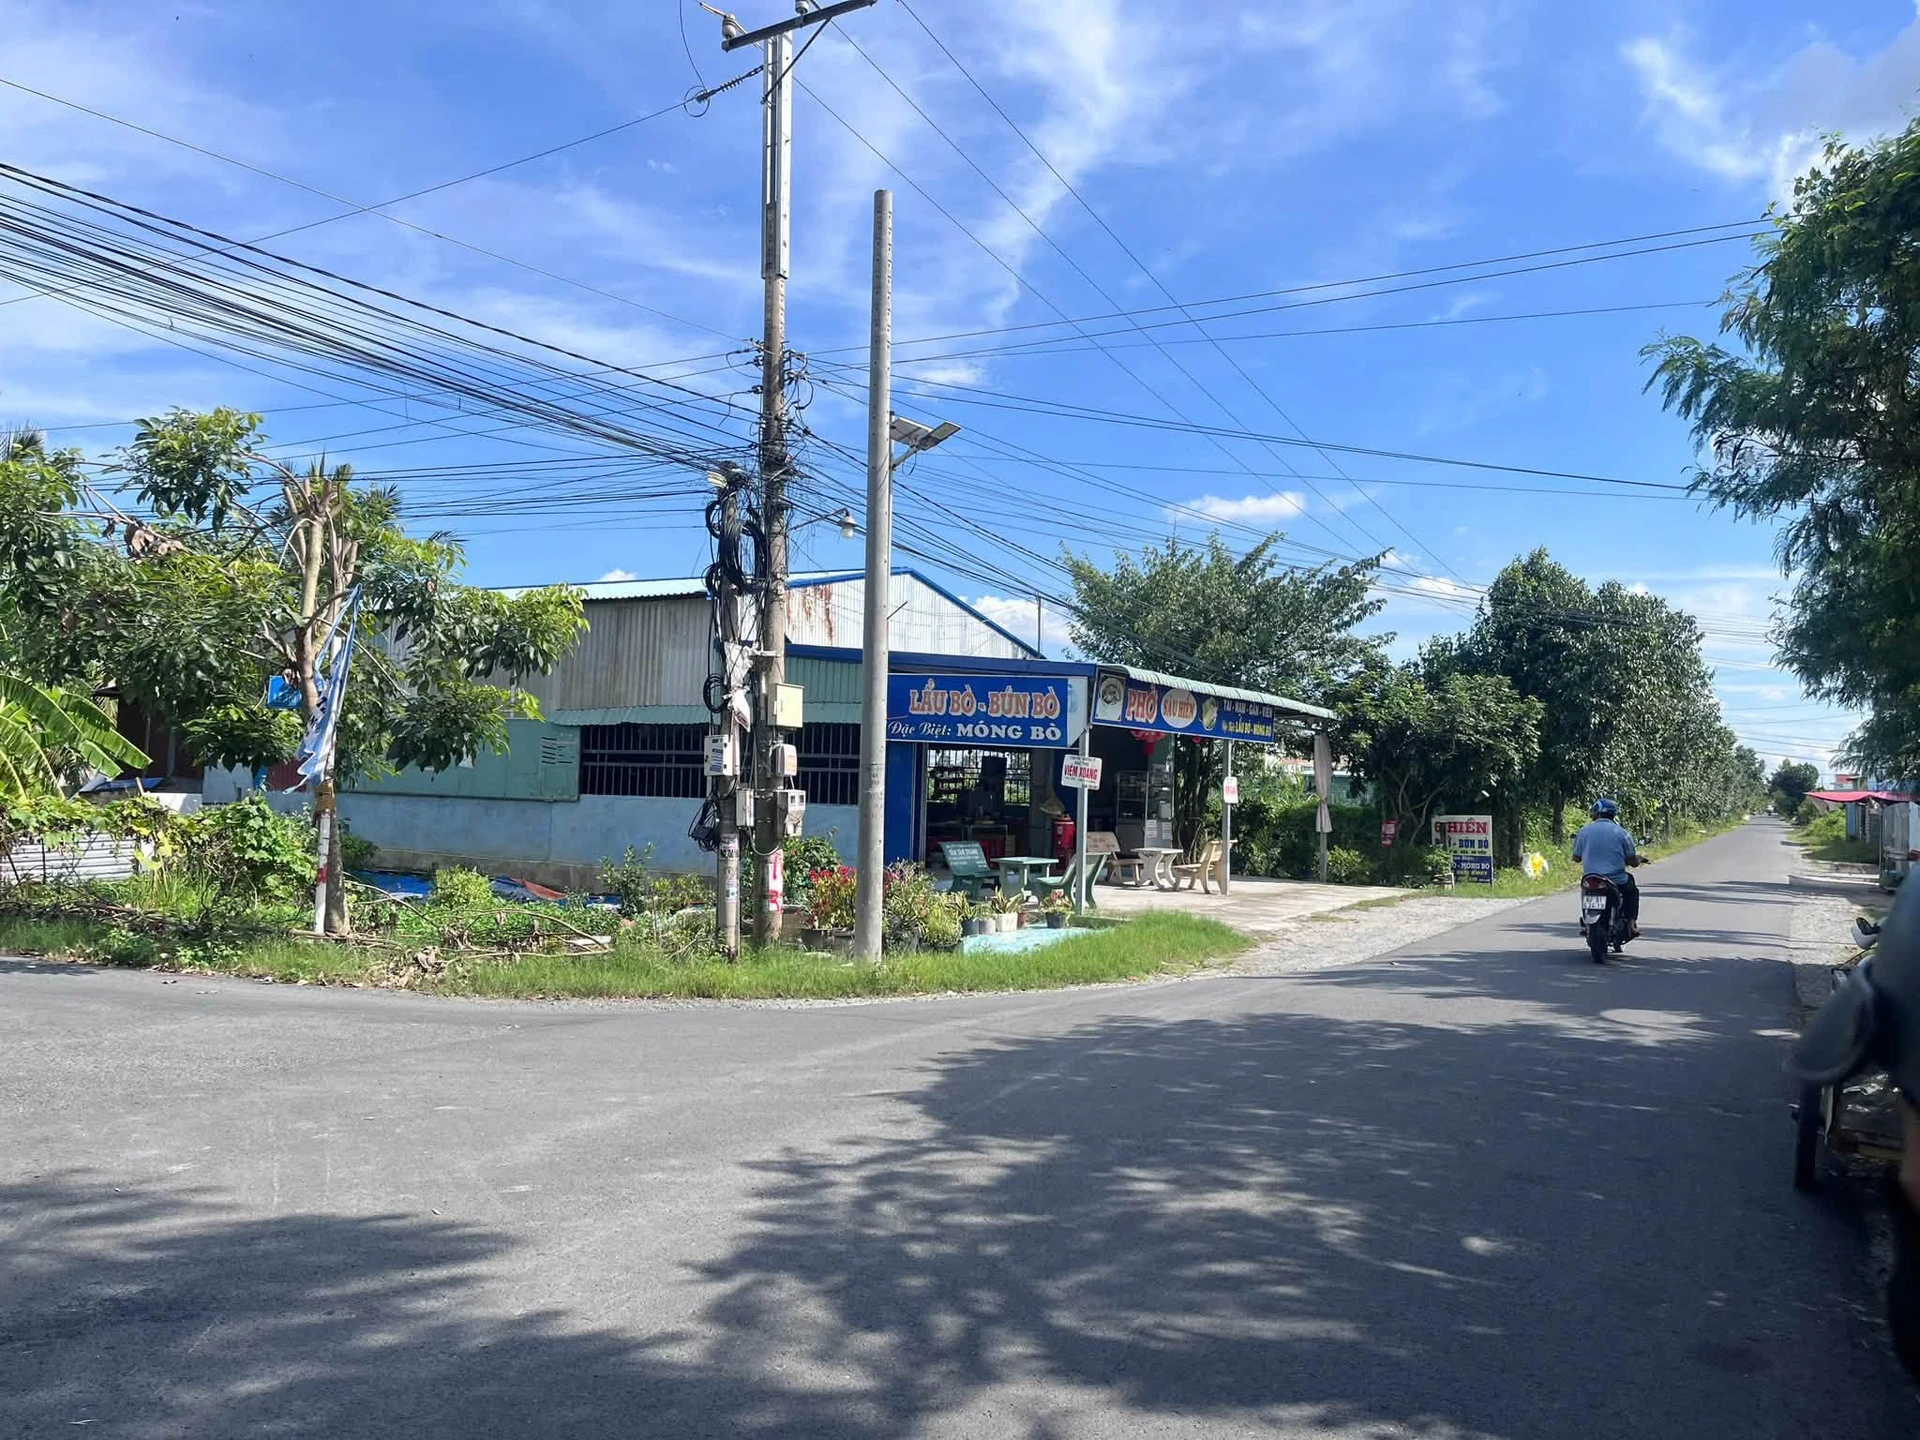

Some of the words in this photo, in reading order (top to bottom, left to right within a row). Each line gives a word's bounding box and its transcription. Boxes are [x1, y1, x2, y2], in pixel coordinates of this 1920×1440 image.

[909, 678, 948, 715] LẨU
[949, 684, 976, 717] BÒ
[988, 685, 1031, 719] BÚN
[1031, 686, 1061, 720] BÒ
[1125, 683, 1158, 724] PHỞ
[957, 720, 1023, 739] MÓNG
[1030, 721, 1061, 741] BÒ
